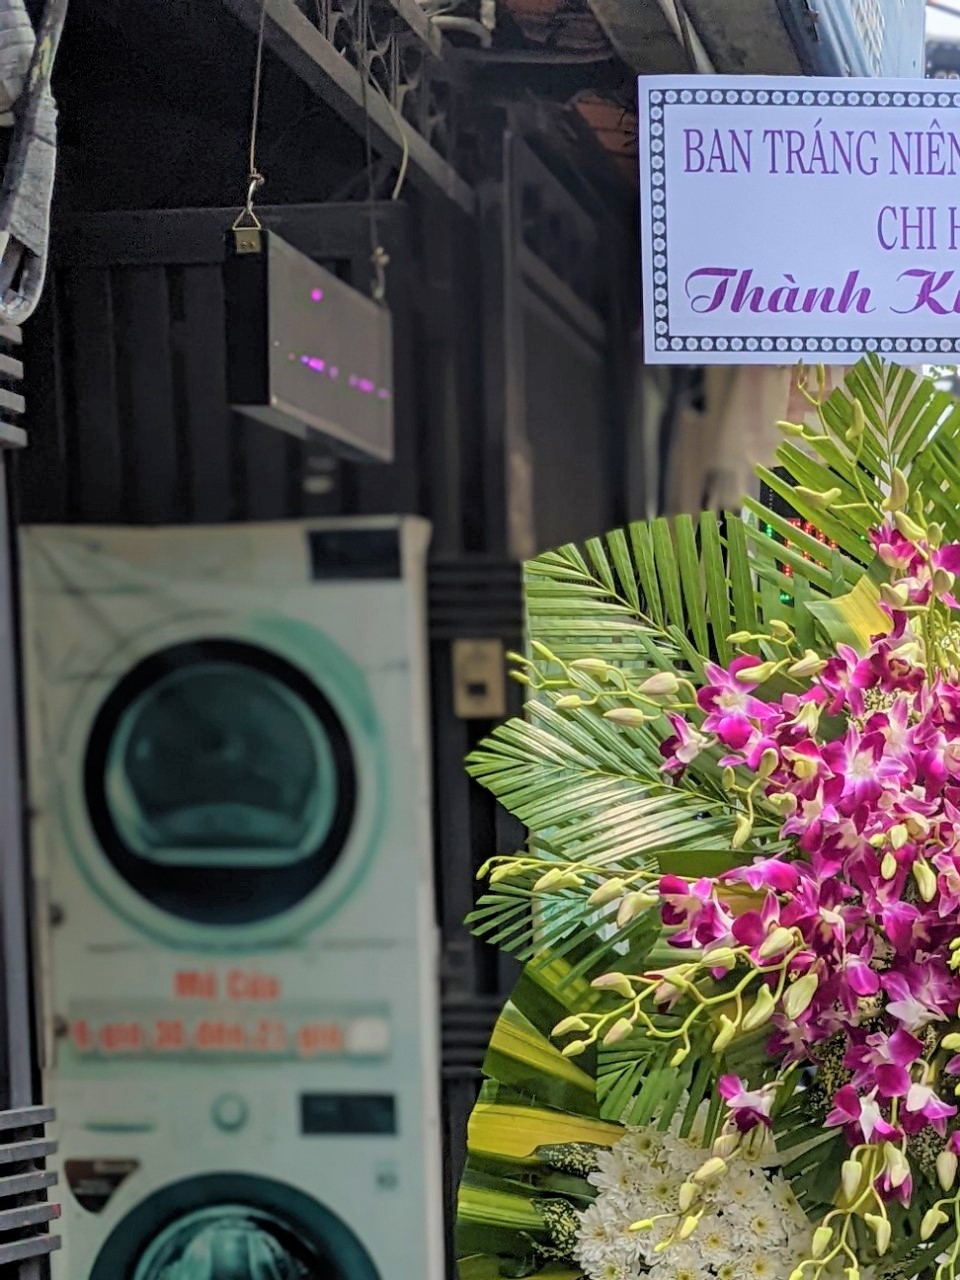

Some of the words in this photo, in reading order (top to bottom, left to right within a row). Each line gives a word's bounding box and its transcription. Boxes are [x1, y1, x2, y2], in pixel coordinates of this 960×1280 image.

[683, 128, 753, 174] BAN
[762, 117, 879, 176] TRÁNG
[877, 205, 937, 251] CHI
[684, 267, 877, 315] Thành
